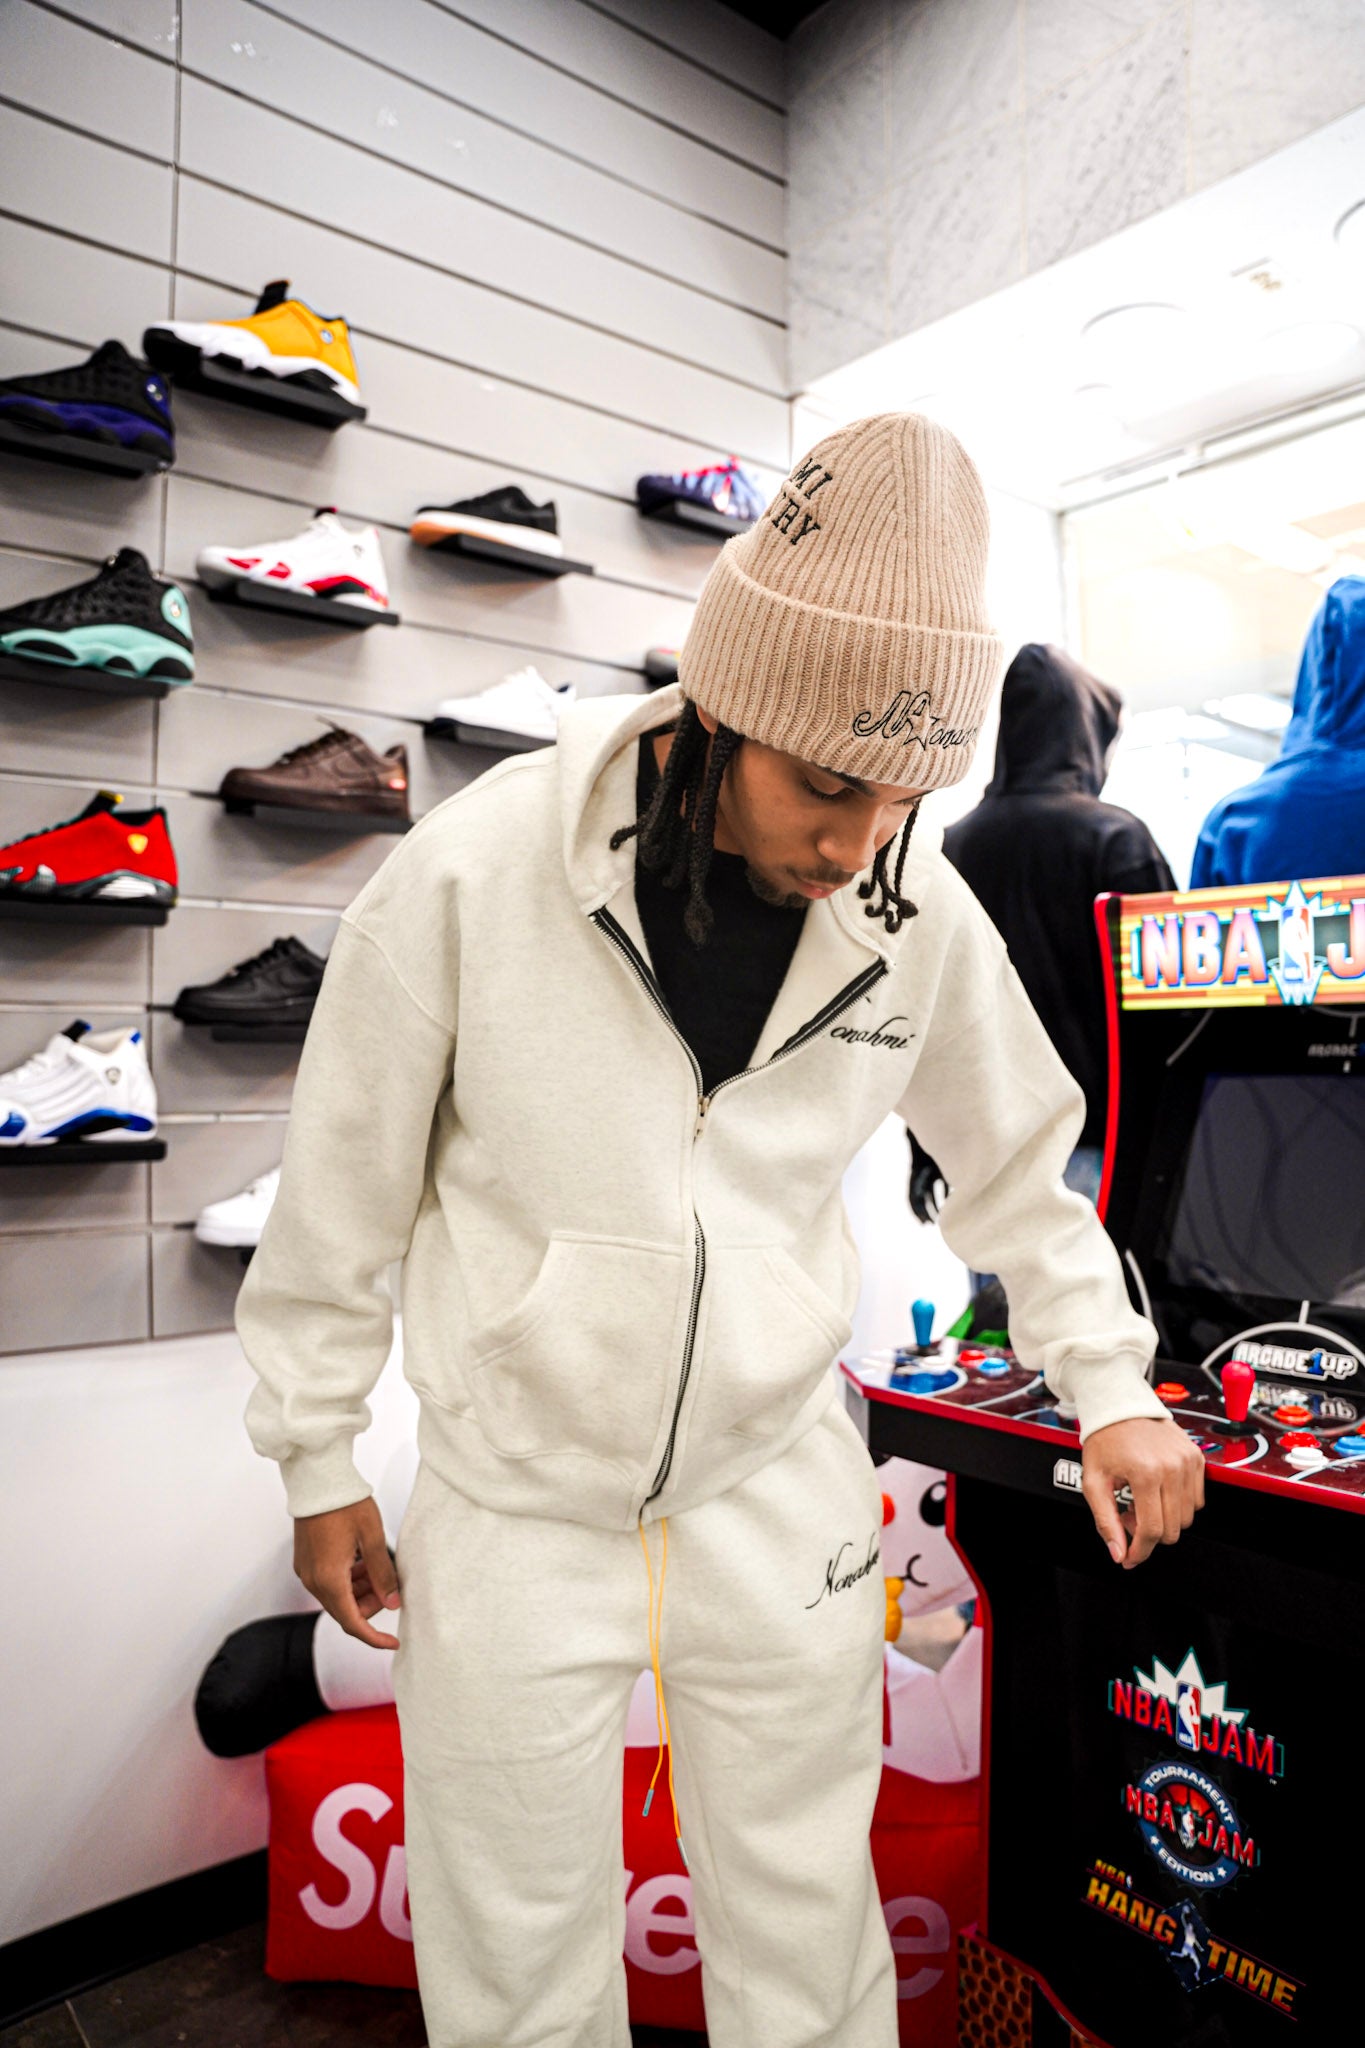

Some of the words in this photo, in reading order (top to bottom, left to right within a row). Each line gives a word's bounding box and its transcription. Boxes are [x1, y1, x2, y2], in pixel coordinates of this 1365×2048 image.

[1140, 911, 1269, 988] NBA
[829, 1016, 916, 1050] onahmi
[1114, 1678, 1174, 1737] NBA
[1201, 1712, 1275, 1777] JAM
[1126, 1783, 1177, 1833] NBA
[1197, 1819, 1255, 1868] JAM
[1144, 1765, 1235, 1824] TOURNAMENT
[1158, 1847, 1216, 1883] EDITION
[1086, 1876, 1178, 1946] HANG
[1206, 1938, 1298, 2013] TIME
